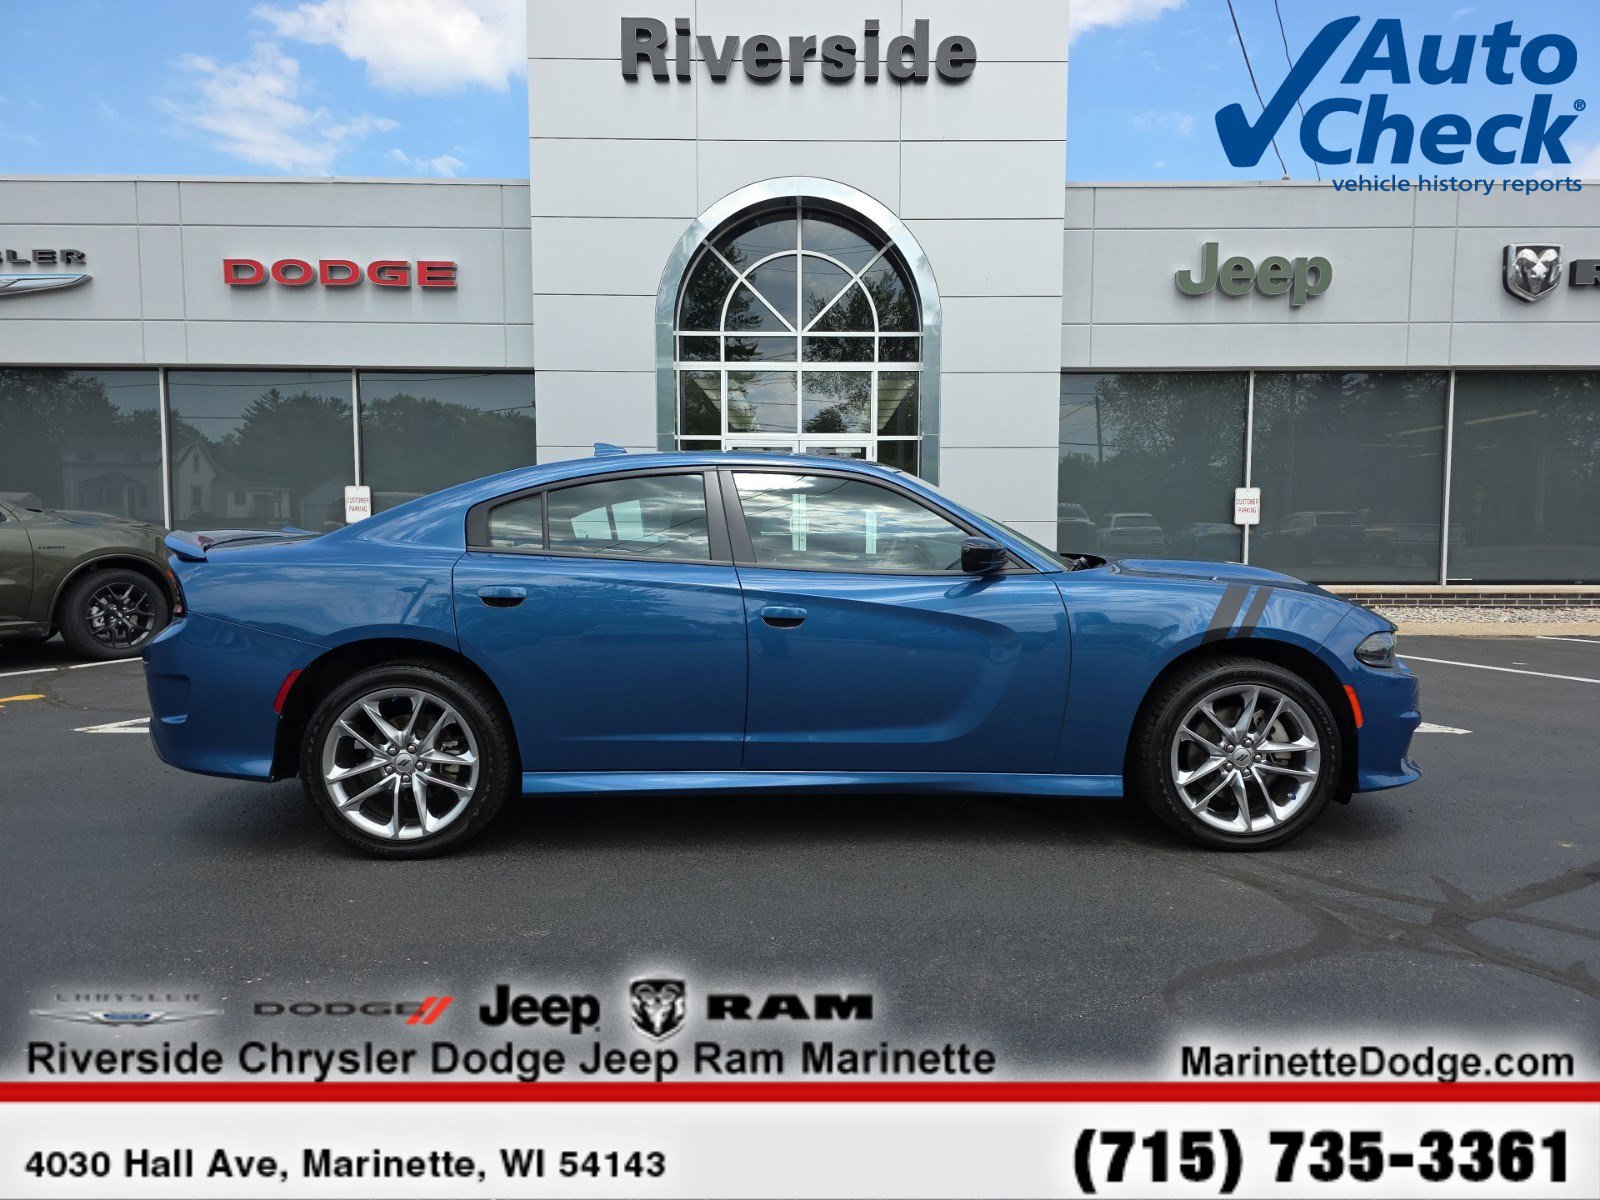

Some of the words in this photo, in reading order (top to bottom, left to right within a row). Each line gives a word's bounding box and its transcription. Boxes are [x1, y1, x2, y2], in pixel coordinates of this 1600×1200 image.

[620, 16, 977, 83] Riverside
[0, 249, 86, 264] LER
[223, 258, 458, 289] DODGE
[1175, 242, 1333, 307] Jeep
